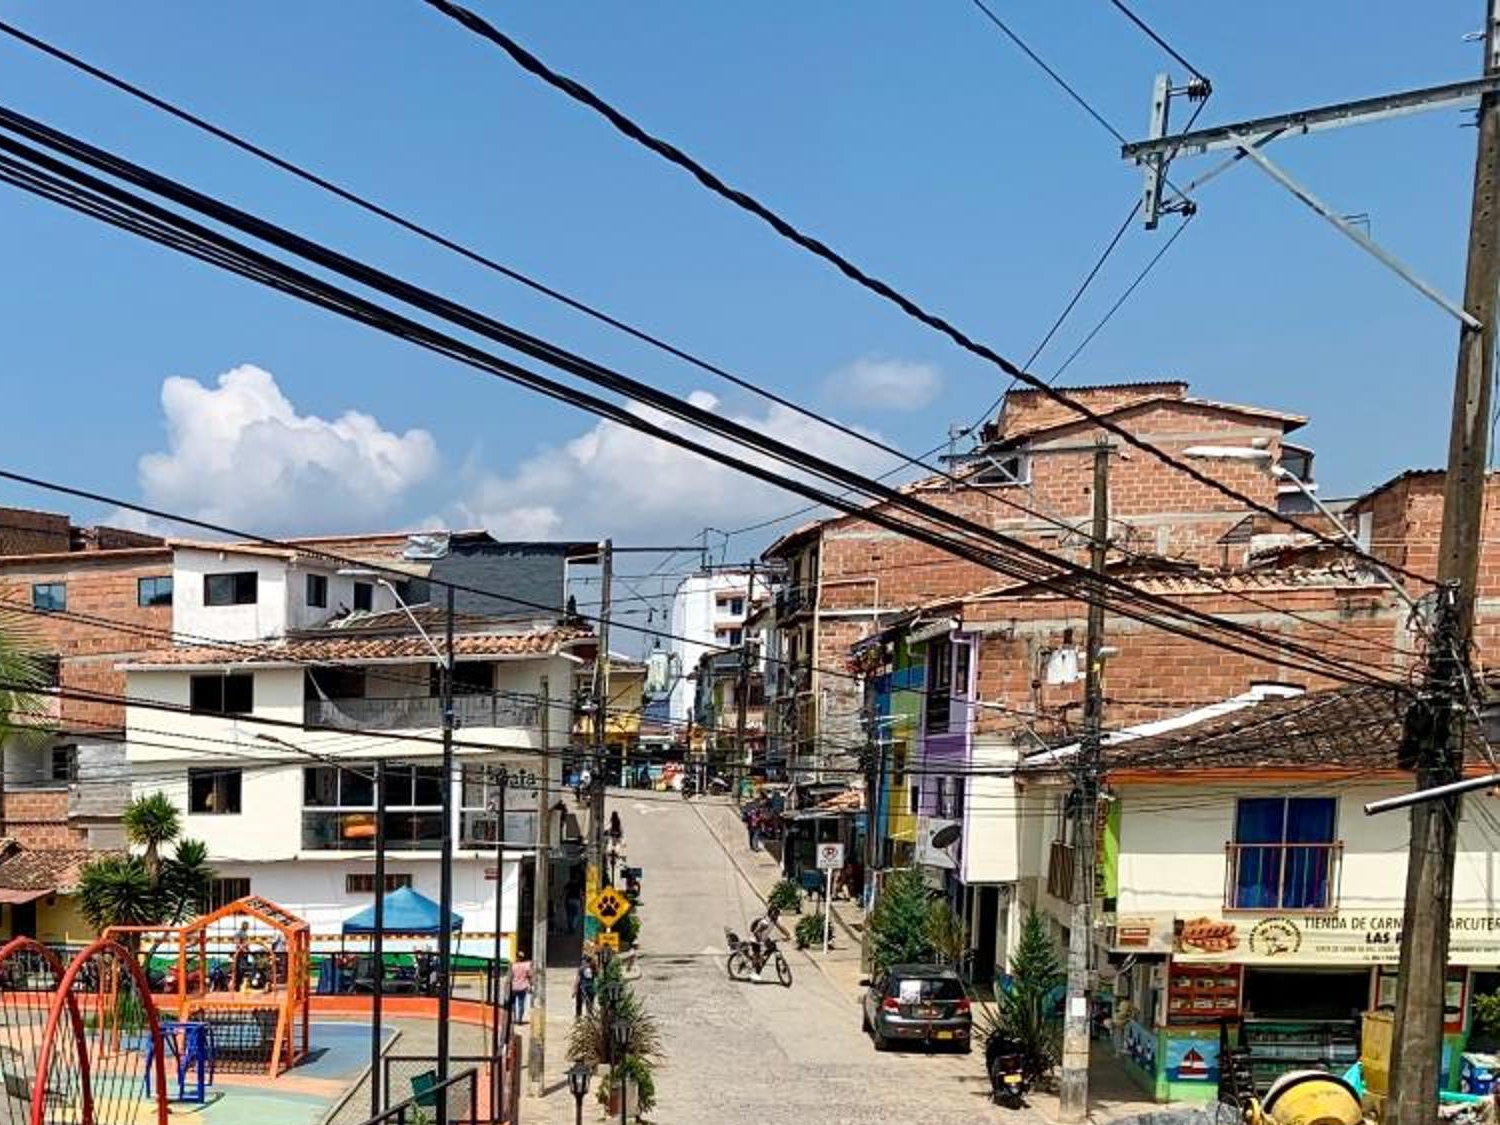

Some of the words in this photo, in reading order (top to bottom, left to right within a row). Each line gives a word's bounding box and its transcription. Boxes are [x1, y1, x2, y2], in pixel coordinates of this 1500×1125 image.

[1304, 917, 1347, 929] TIENDA
[1351, 917, 1366, 930] DE
[1370, 917, 1402, 930] CARN
[1365, 932, 1391, 945] LAS
